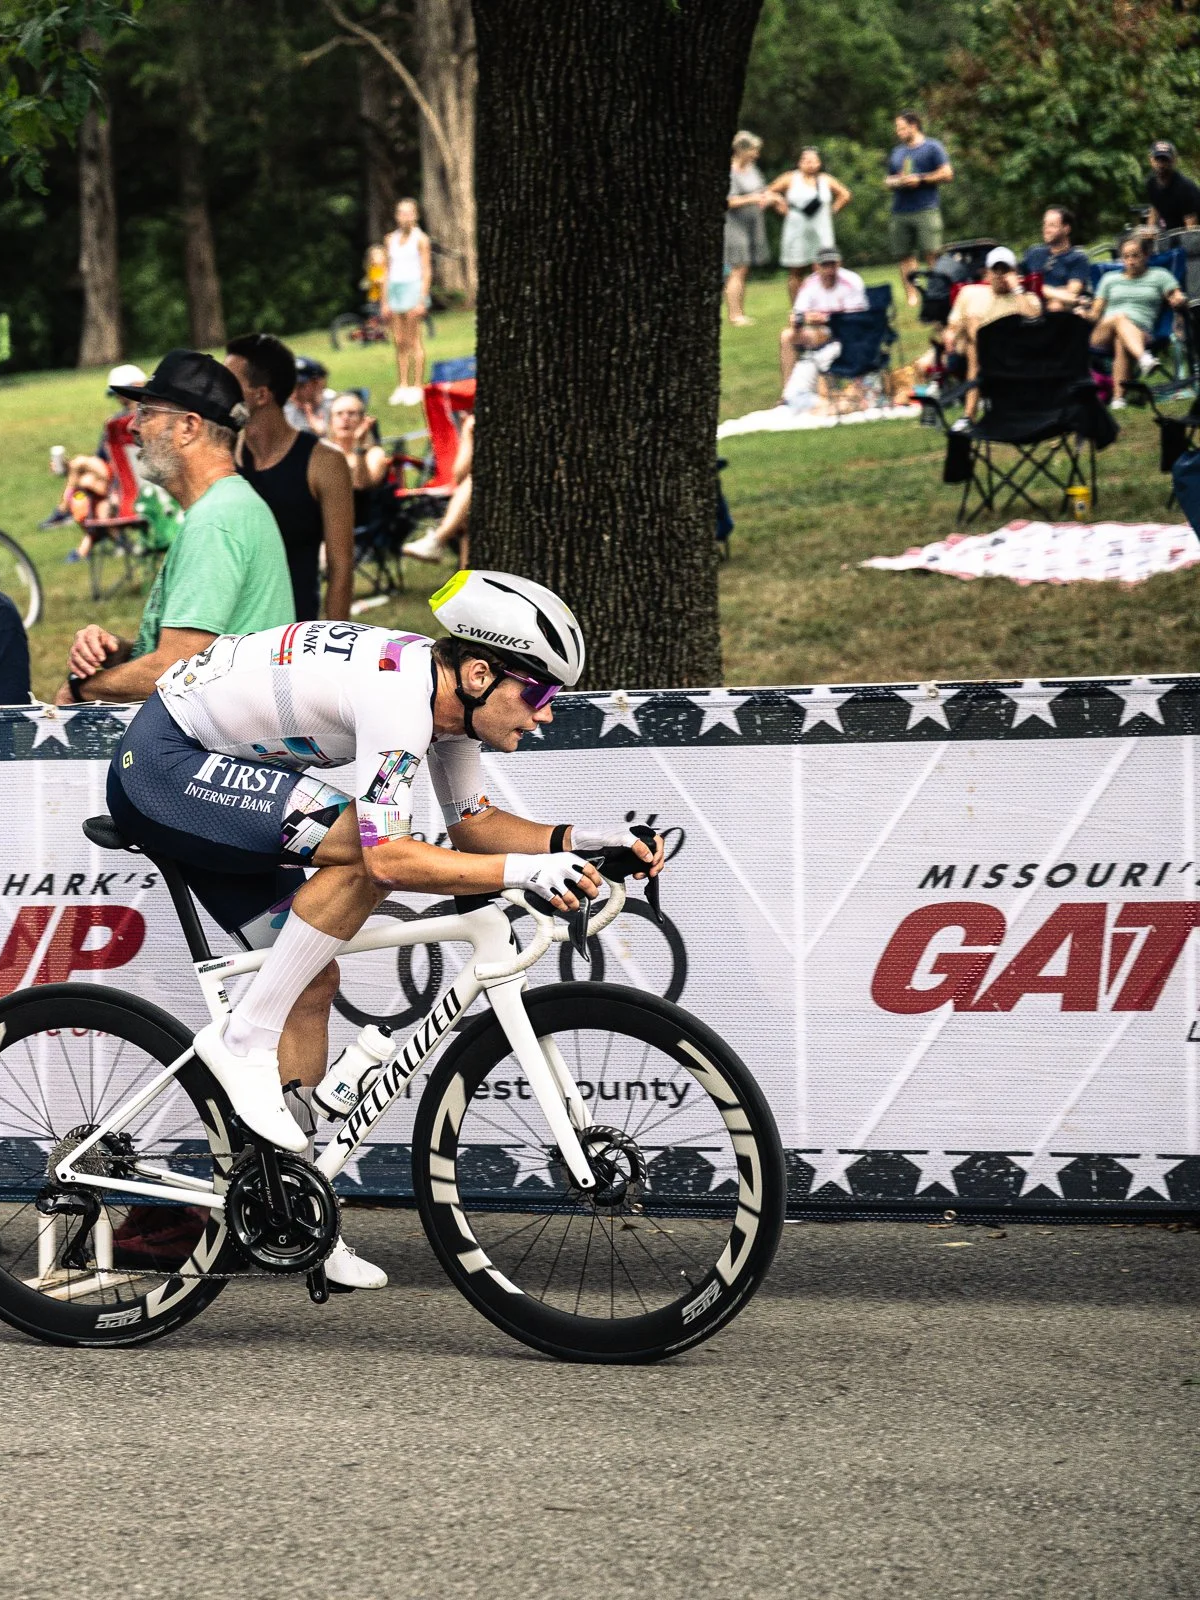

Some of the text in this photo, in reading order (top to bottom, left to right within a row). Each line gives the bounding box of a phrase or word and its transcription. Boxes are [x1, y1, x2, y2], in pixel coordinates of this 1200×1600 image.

[303, 624, 327, 655] BANK
[454, 623, 535, 650] S-WORKS
[192, 752, 289, 795] FIRST
[183, 781, 276, 813] INTERNET BANK
[918, 862, 1200, 889] MISSOURI'
[870, 900, 1200, 1015] GAT
[337, 987, 461, 1158] SPECIALIZED
[334, 1081, 360, 1102] FIRS
[472, 1076, 691, 1108] est ounty
